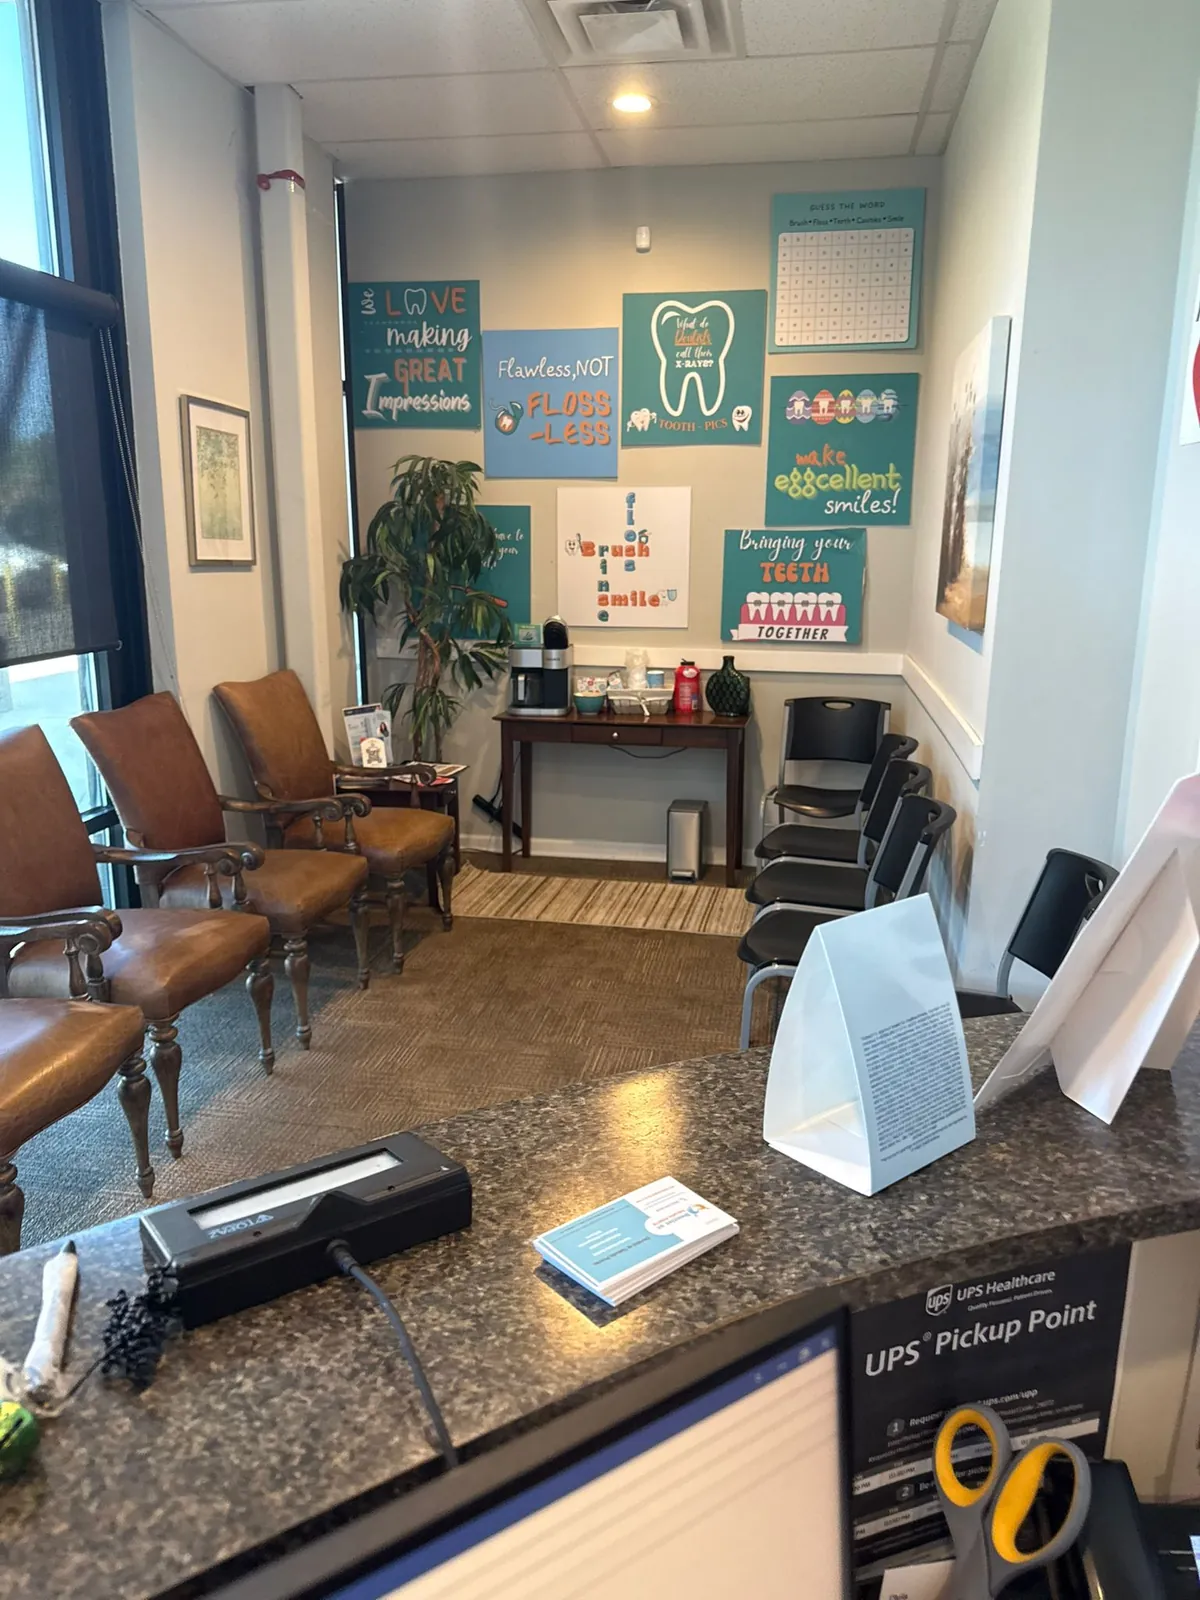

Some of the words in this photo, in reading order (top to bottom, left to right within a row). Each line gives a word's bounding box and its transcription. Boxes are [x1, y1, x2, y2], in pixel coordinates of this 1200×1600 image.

[810, 202, 835, 211] GUESS
[839, 202, 855, 210] THE
[859, 201, 886, 209] WORD
[700, 316, 709, 329] do
[386, 320, 472, 352] making
[394, 357, 467, 396] GREAT
[361, 372, 472, 421] Impressions
[527, 390, 612, 418] FLOSS
[658, 418, 696, 432] TOOTH
[704, 418, 728, 431] PICS
[796, 444, 846, 467] make
[774, 463, 902, 499] eggcellent
[824, 488, 901, 514] smiles!
[581, 541, 650, 557] Brush
[739, 529, 806, 562] Bringing
[814, 536, 854, 561] your
[760, 562, 830, 583] TEETH
[597, 590, 660, 607] smile
[757, 626, 829, 640] TOGETHER
[956, 1284, 984, 1301] UPS
[986, 1271, 1056, 1294] Healthcare
[935, 1319, 1022, 1355] Pickup
[1028, 1300, 1097, 1333] Point
